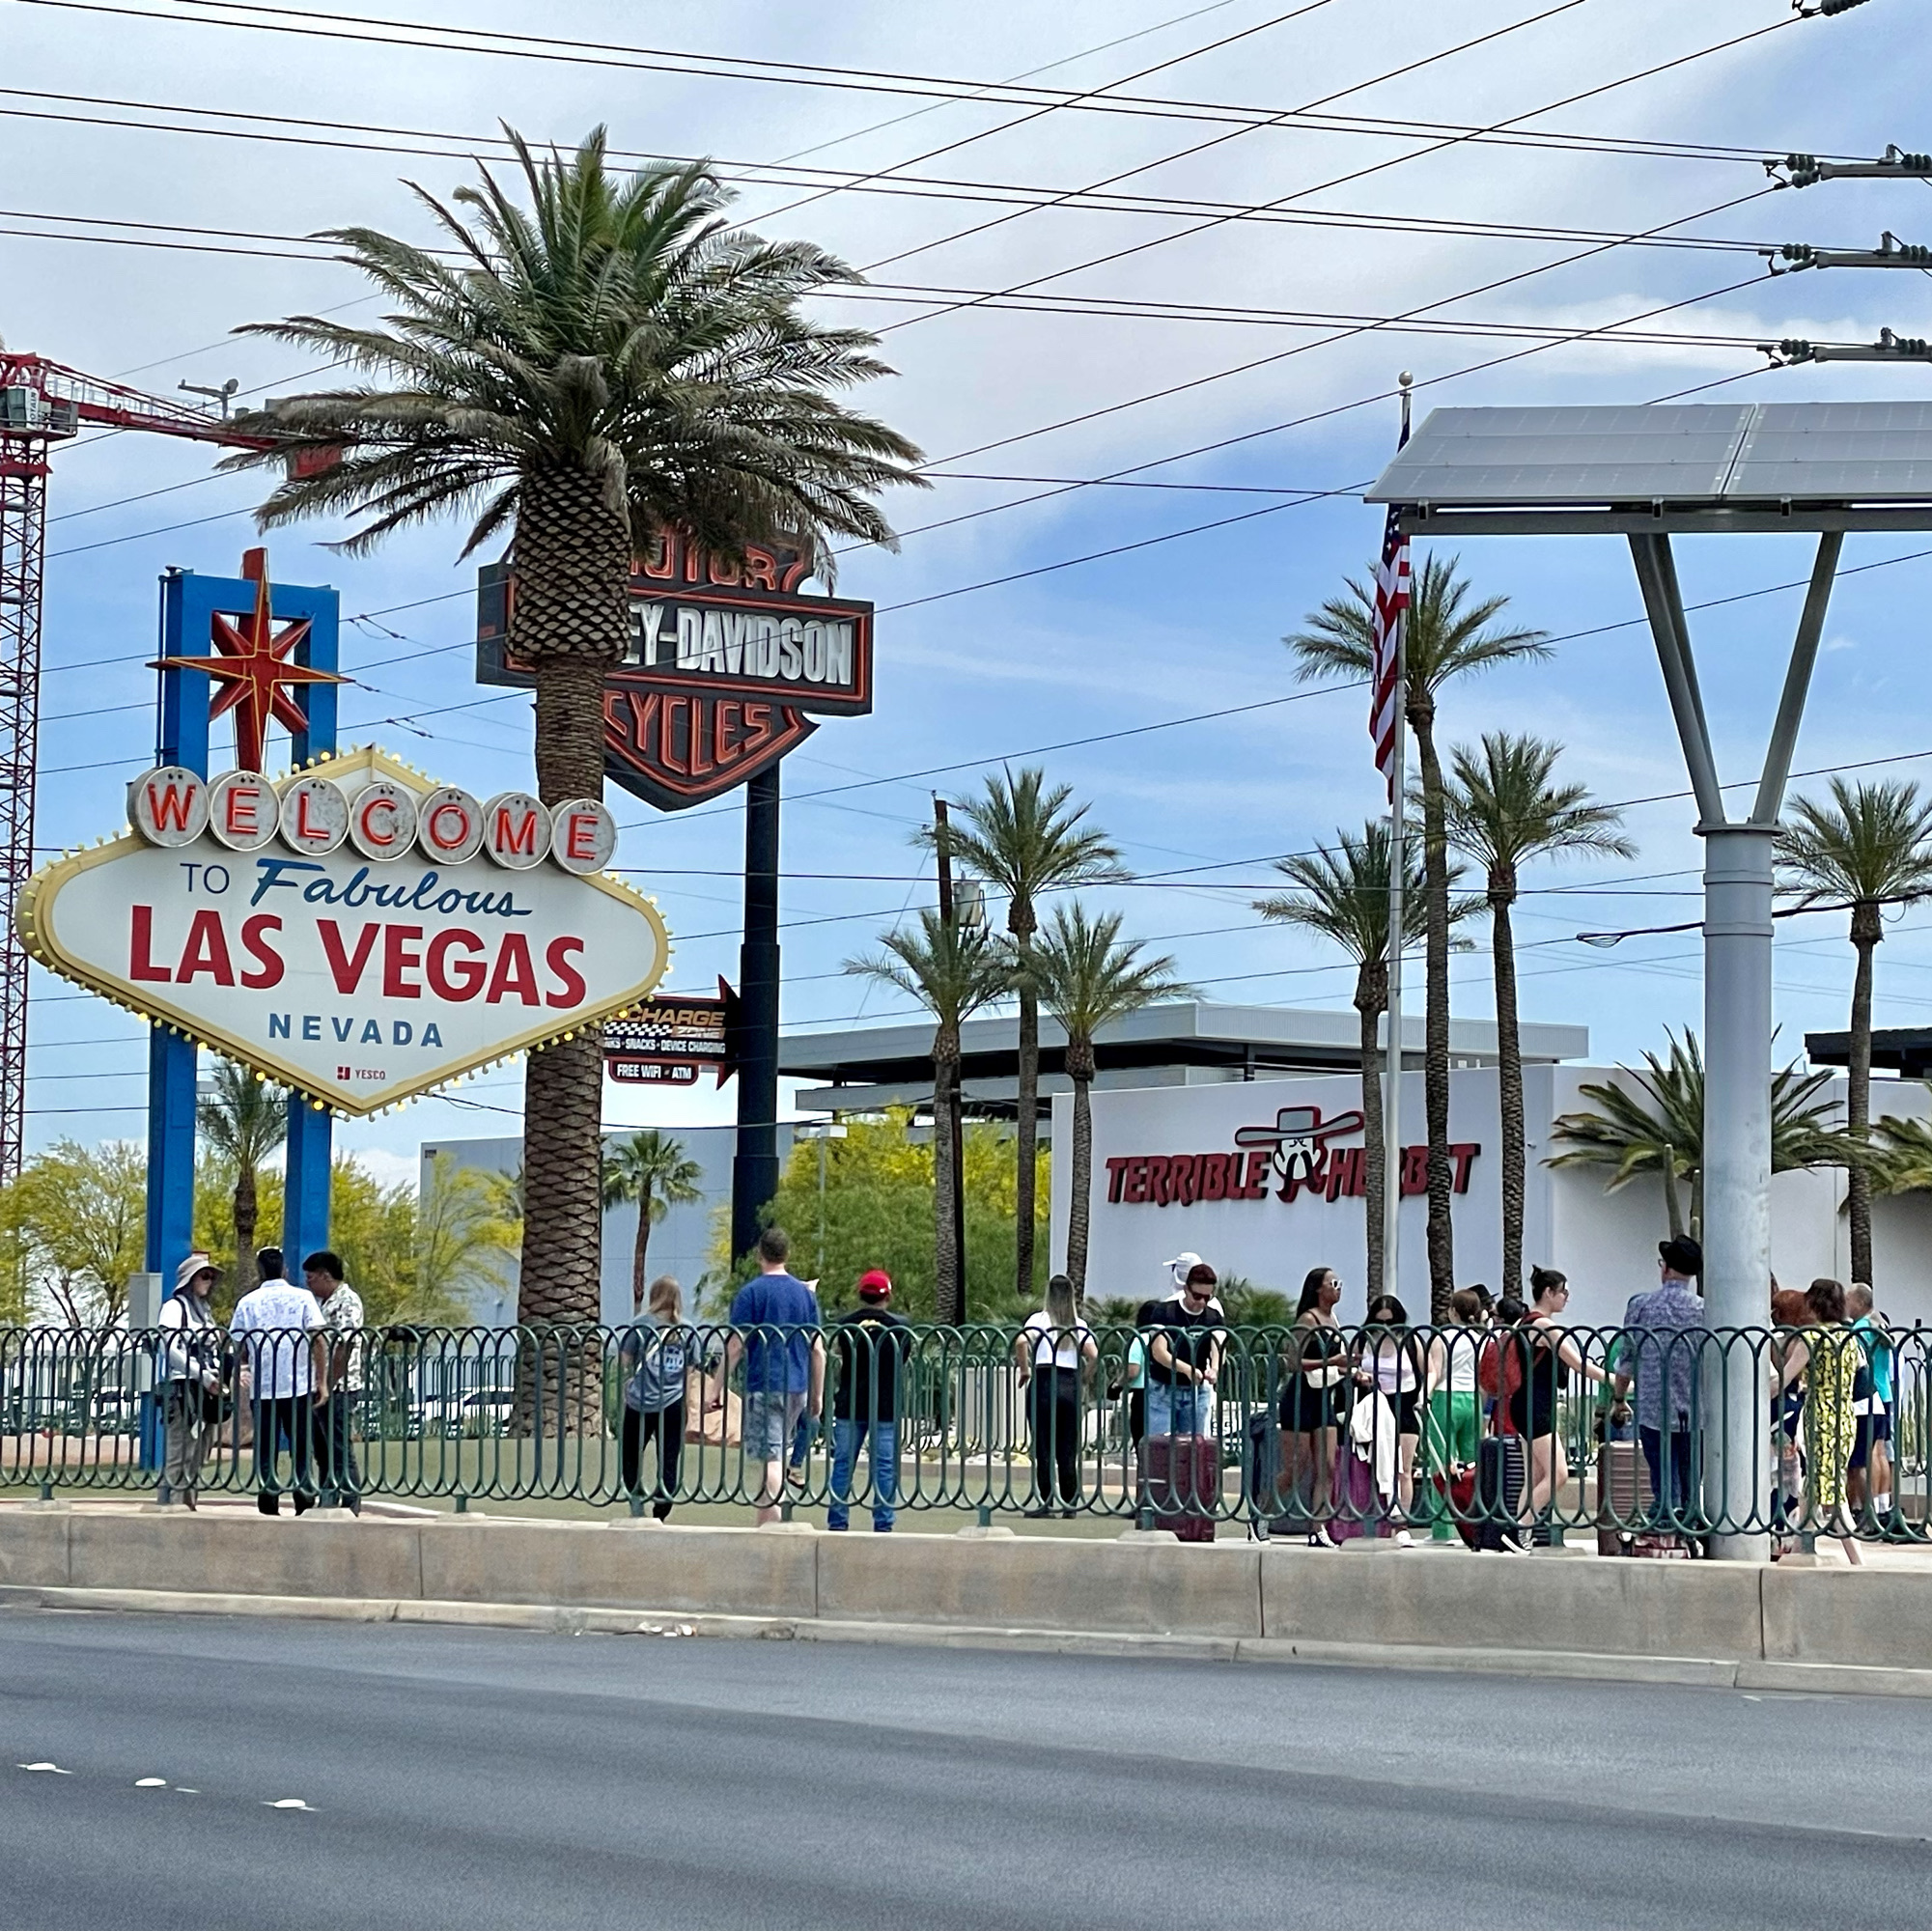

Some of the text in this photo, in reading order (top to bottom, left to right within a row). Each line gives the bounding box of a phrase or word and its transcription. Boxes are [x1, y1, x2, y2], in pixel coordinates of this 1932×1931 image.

[604, 689, 771, 776] CYCLES
[147, 783, 600, 860] WELCOME
[180, 858, 533, 917] TO Fabulous
[129, 905, 587, 1010] LAS VEGAS
[268, 1013, 443, 1049] NEVADA
[625, 1038, 657, 1050] SNACKS
[660, 1040, 687, 1052] DEVICE
[688, 1041, 726, 1053] CHARGING
[354, 1069, 386, 1080] YESCO
[617, 1063, 692, 1079] FREE WIFI ATM
[1106, 1151, 1272, 1207] TERRIBLE
